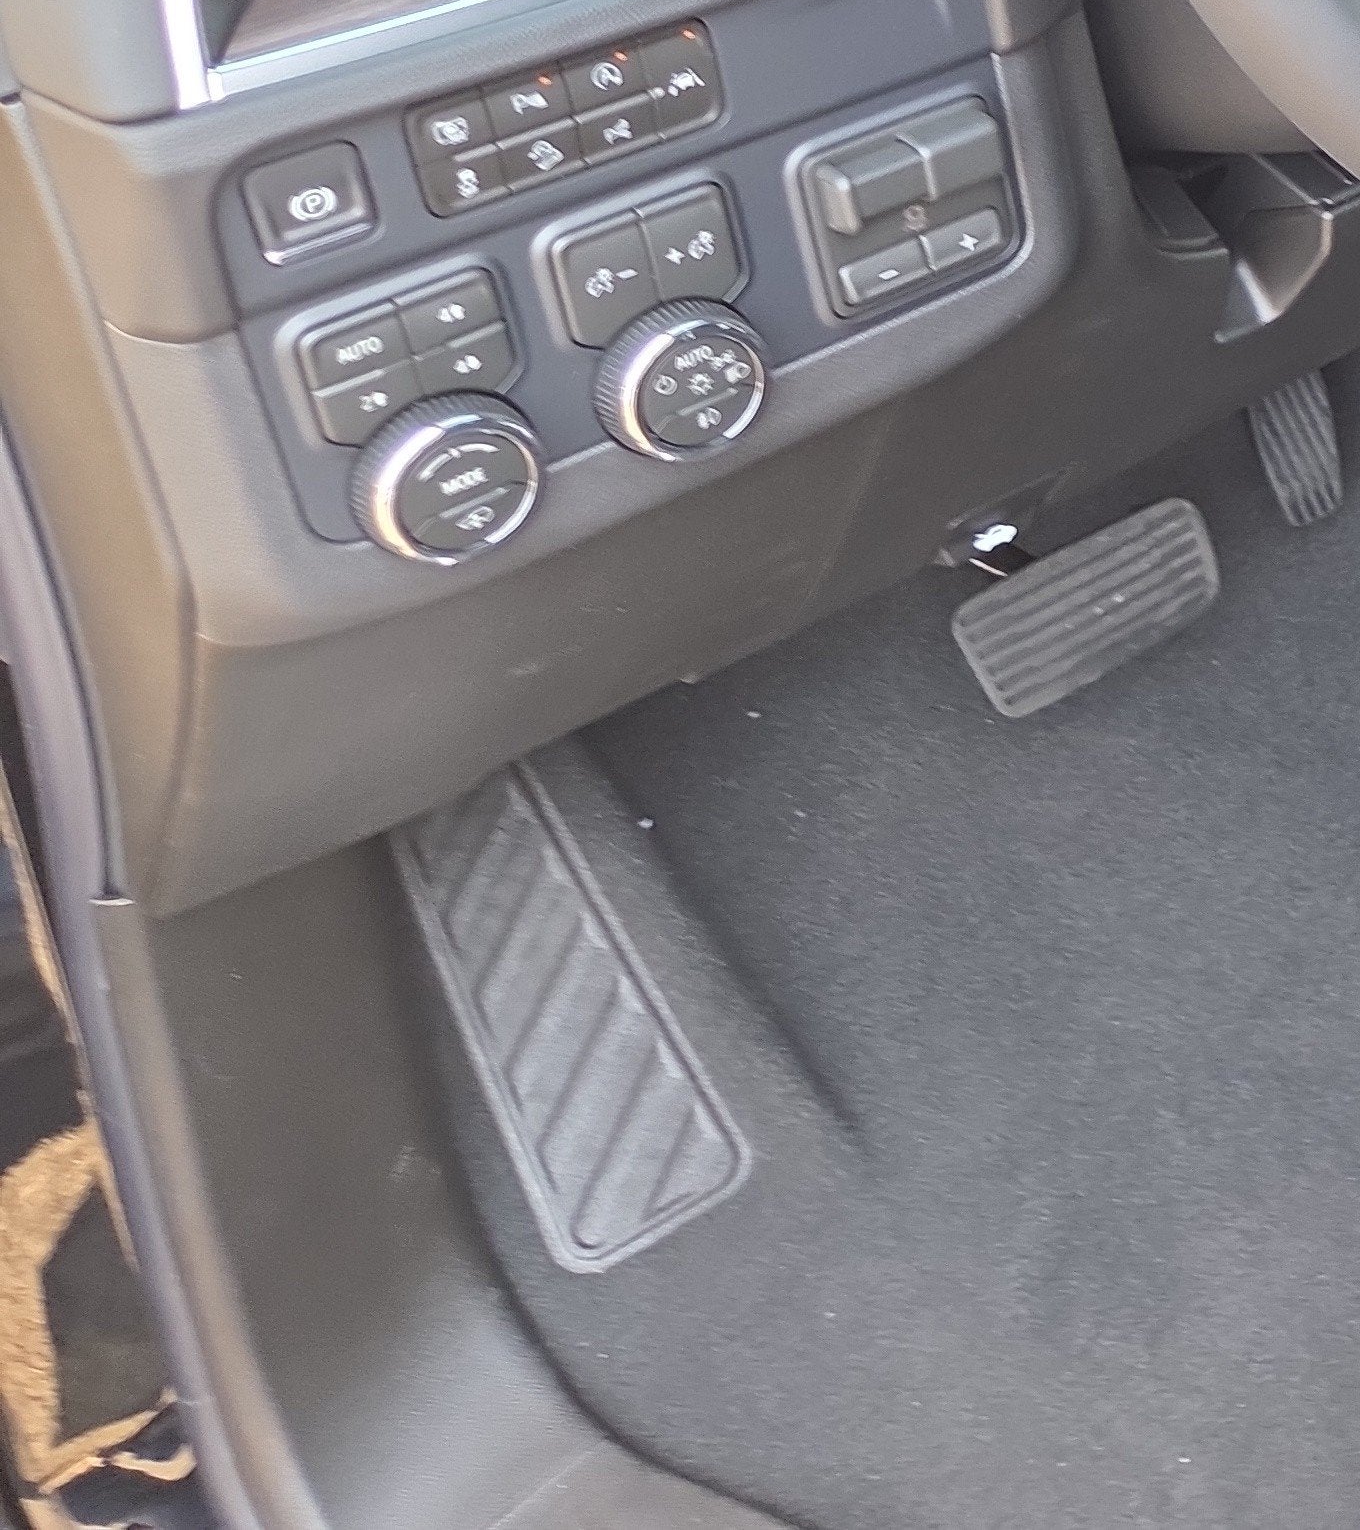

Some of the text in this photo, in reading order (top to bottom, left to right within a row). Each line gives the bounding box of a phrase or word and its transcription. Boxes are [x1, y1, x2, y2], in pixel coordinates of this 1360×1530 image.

[335, 336, 384, 366] AUTO
[674, 344, 714, 371] AUTO
[438, 467, 489, 497] MODE
